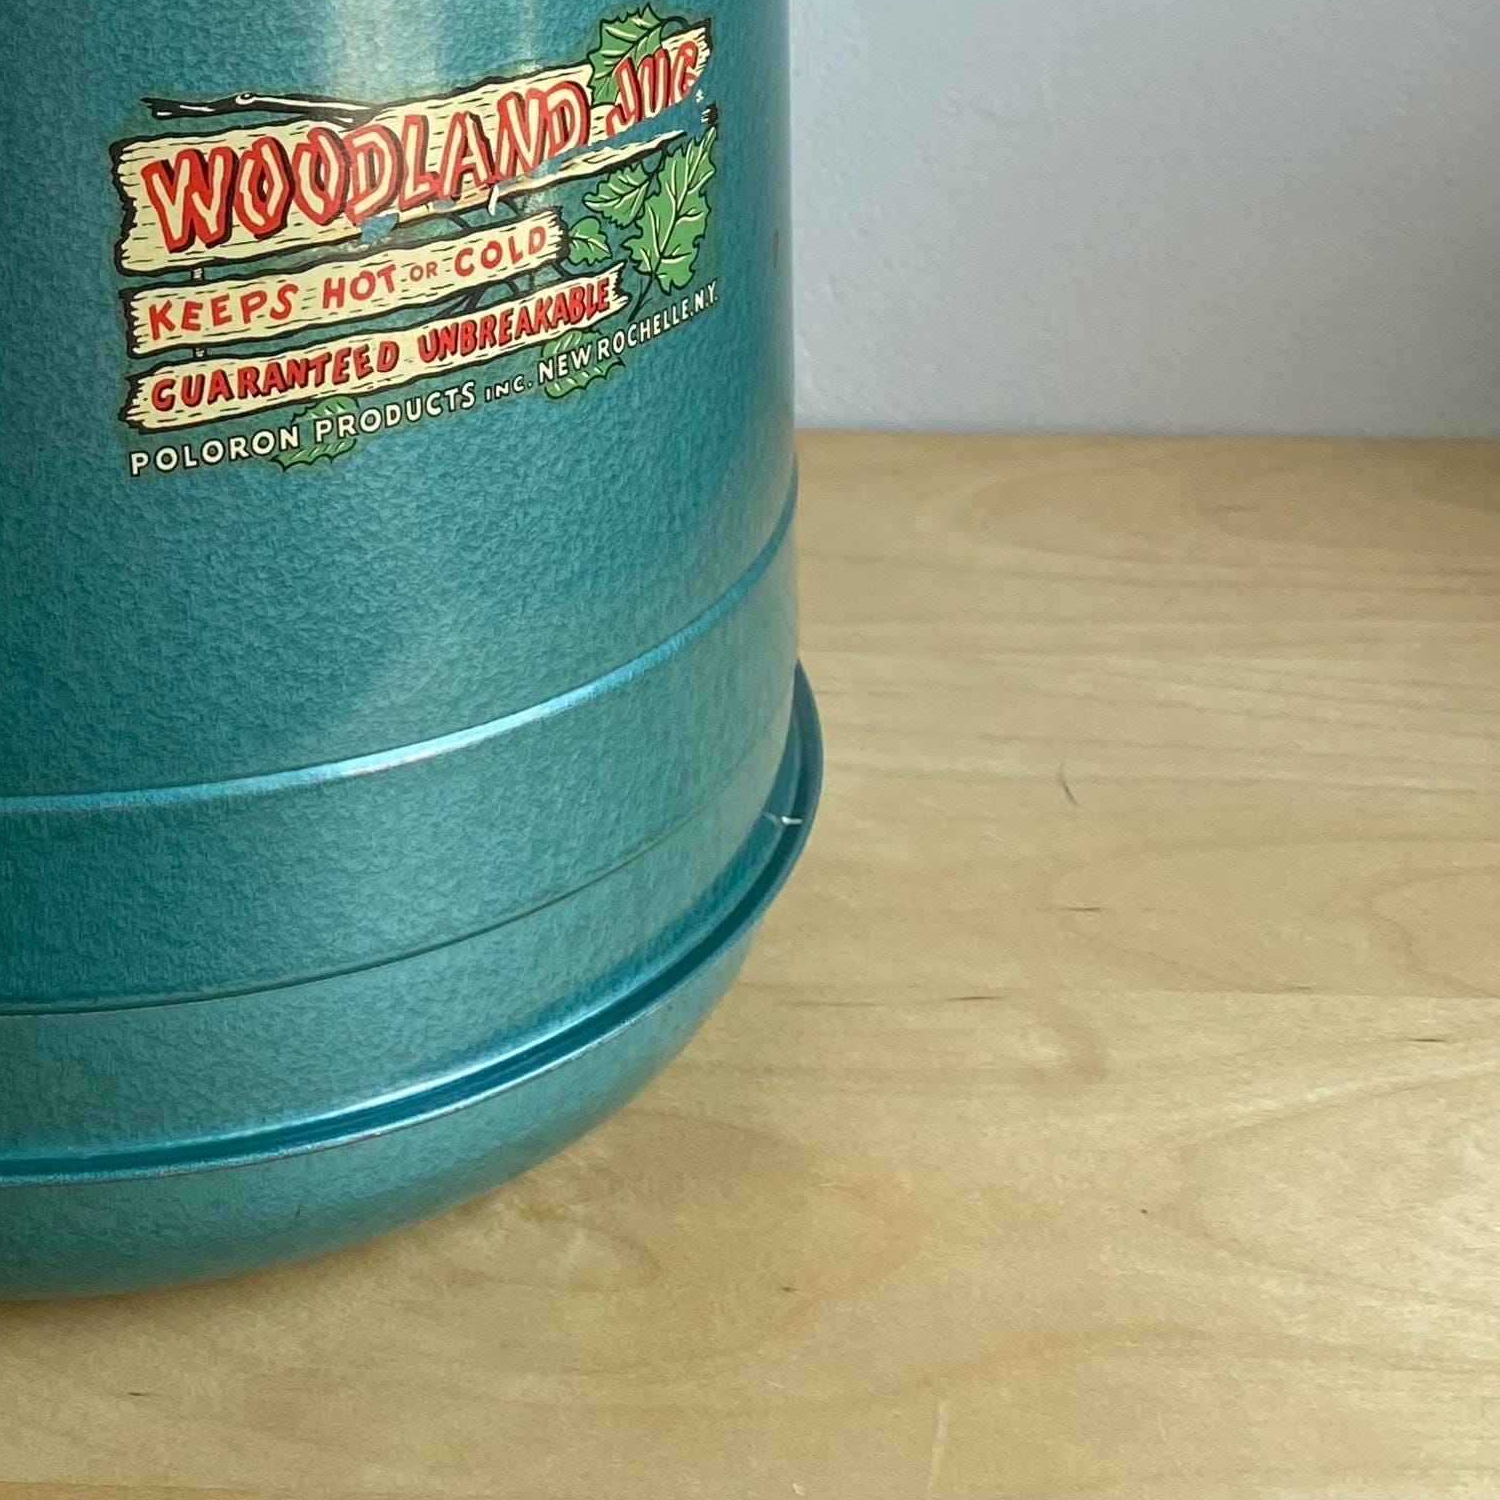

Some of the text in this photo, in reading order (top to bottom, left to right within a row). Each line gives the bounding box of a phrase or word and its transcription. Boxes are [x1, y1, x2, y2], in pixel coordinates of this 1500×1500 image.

[141, 80, 591, 251] WOODLAND
[148, 226, 546, 341] KEEPS HOT OR COLD
[151, 277, 611, 412] GUARANTEED UNBREAKABLE
[129, 425, 300, 476] POLORON
[314, 380, 477, 444] PRODUCTS
[484, 375, 533, 402] INC.
[537, 344, 593, 384] NEW
